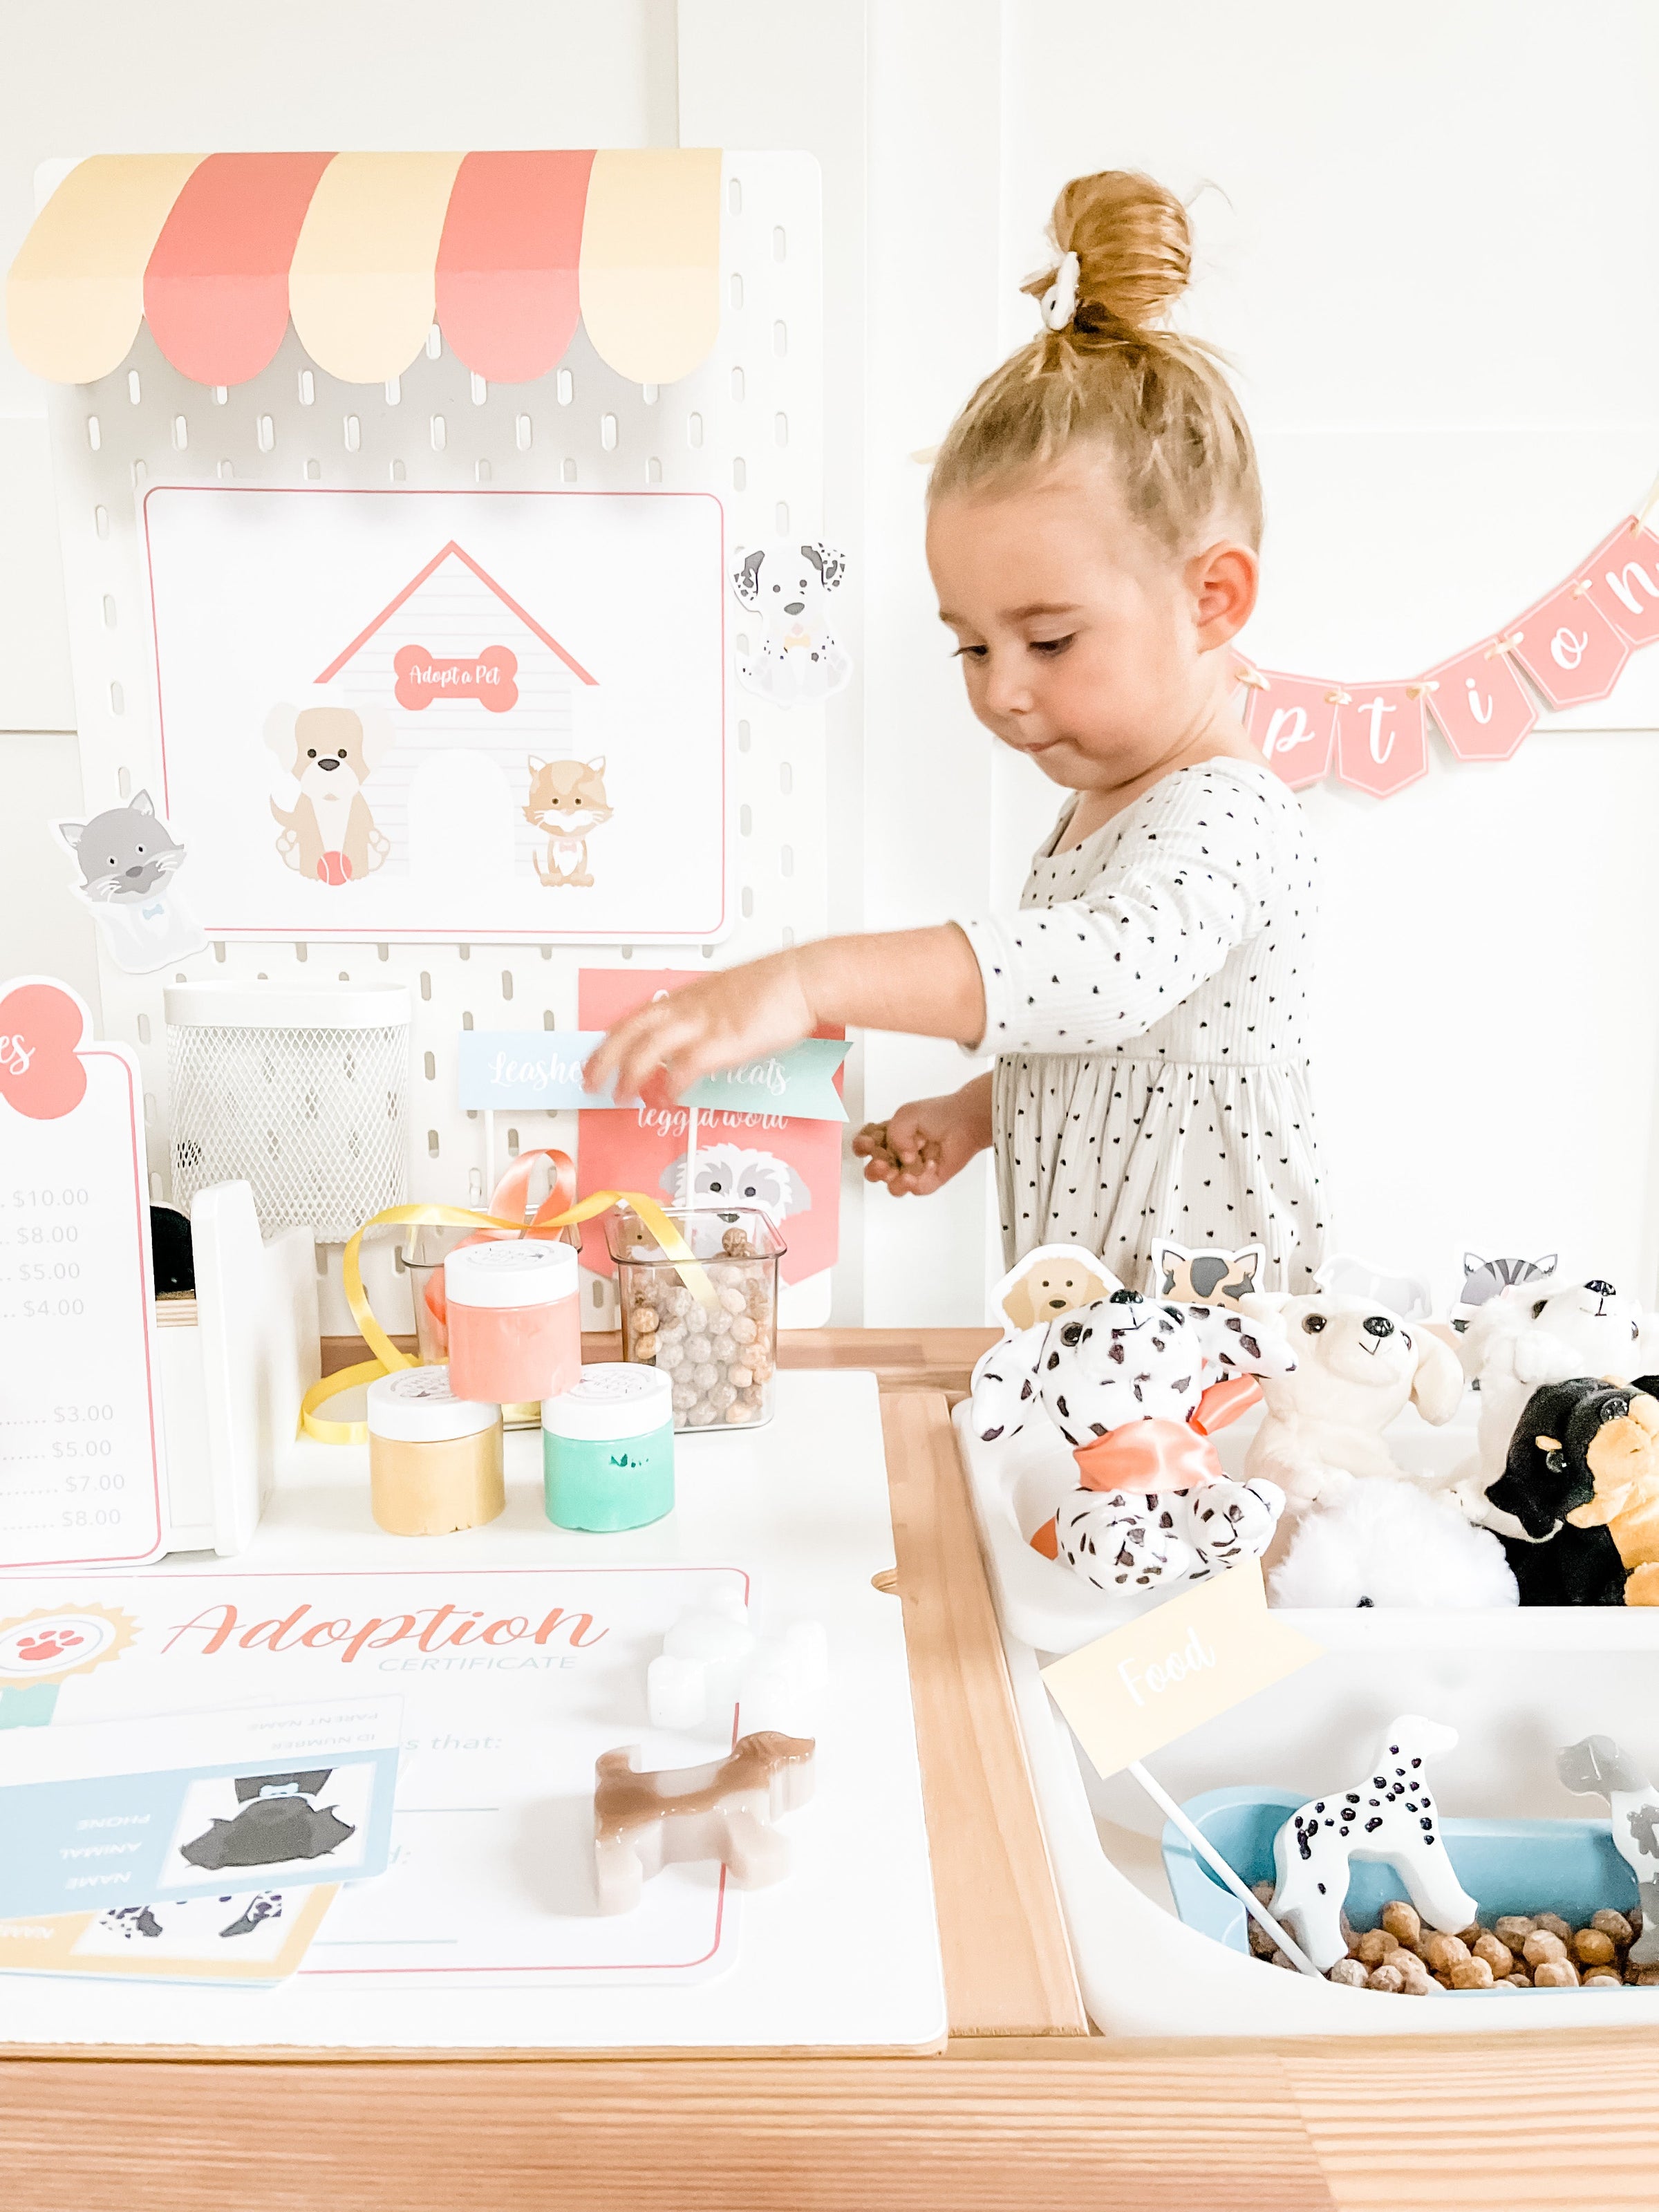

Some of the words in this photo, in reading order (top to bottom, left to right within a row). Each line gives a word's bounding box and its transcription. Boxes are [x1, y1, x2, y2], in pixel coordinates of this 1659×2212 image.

[410, 664, 459, 688] Adopt
[461, 671, 472, 684] a
[476, 665, 500, 684] Pet
[488, 1051, 583, 1091] Leashe
[12, 1189, 88, 1208] $10.00
[17, 1226, 78, 1245] $8.00
[19, 1262, 80, 1282] $5.00
[23, 1299, 85, 1318] $4.00
[53, 1405, 113, 1423] $3.00
[52, 1439, 111, 1458] $5.00
[66, 1474, 125, 1492] $7.00
[62, 1509, 121, 1527] $8.00
[160, 1603, 610, 1662] Adoption
[377, 1655, 578, 1672] CERTIFICATE
[1116, 1626, 1217, 1707] Food
[431, 1734, 503, 1750] that:
[77, 1813, 151, 1831] PHONE
[59, 1841, 142, 1859] ANIMAL
[65, 1871, 133, 1891] NAME
